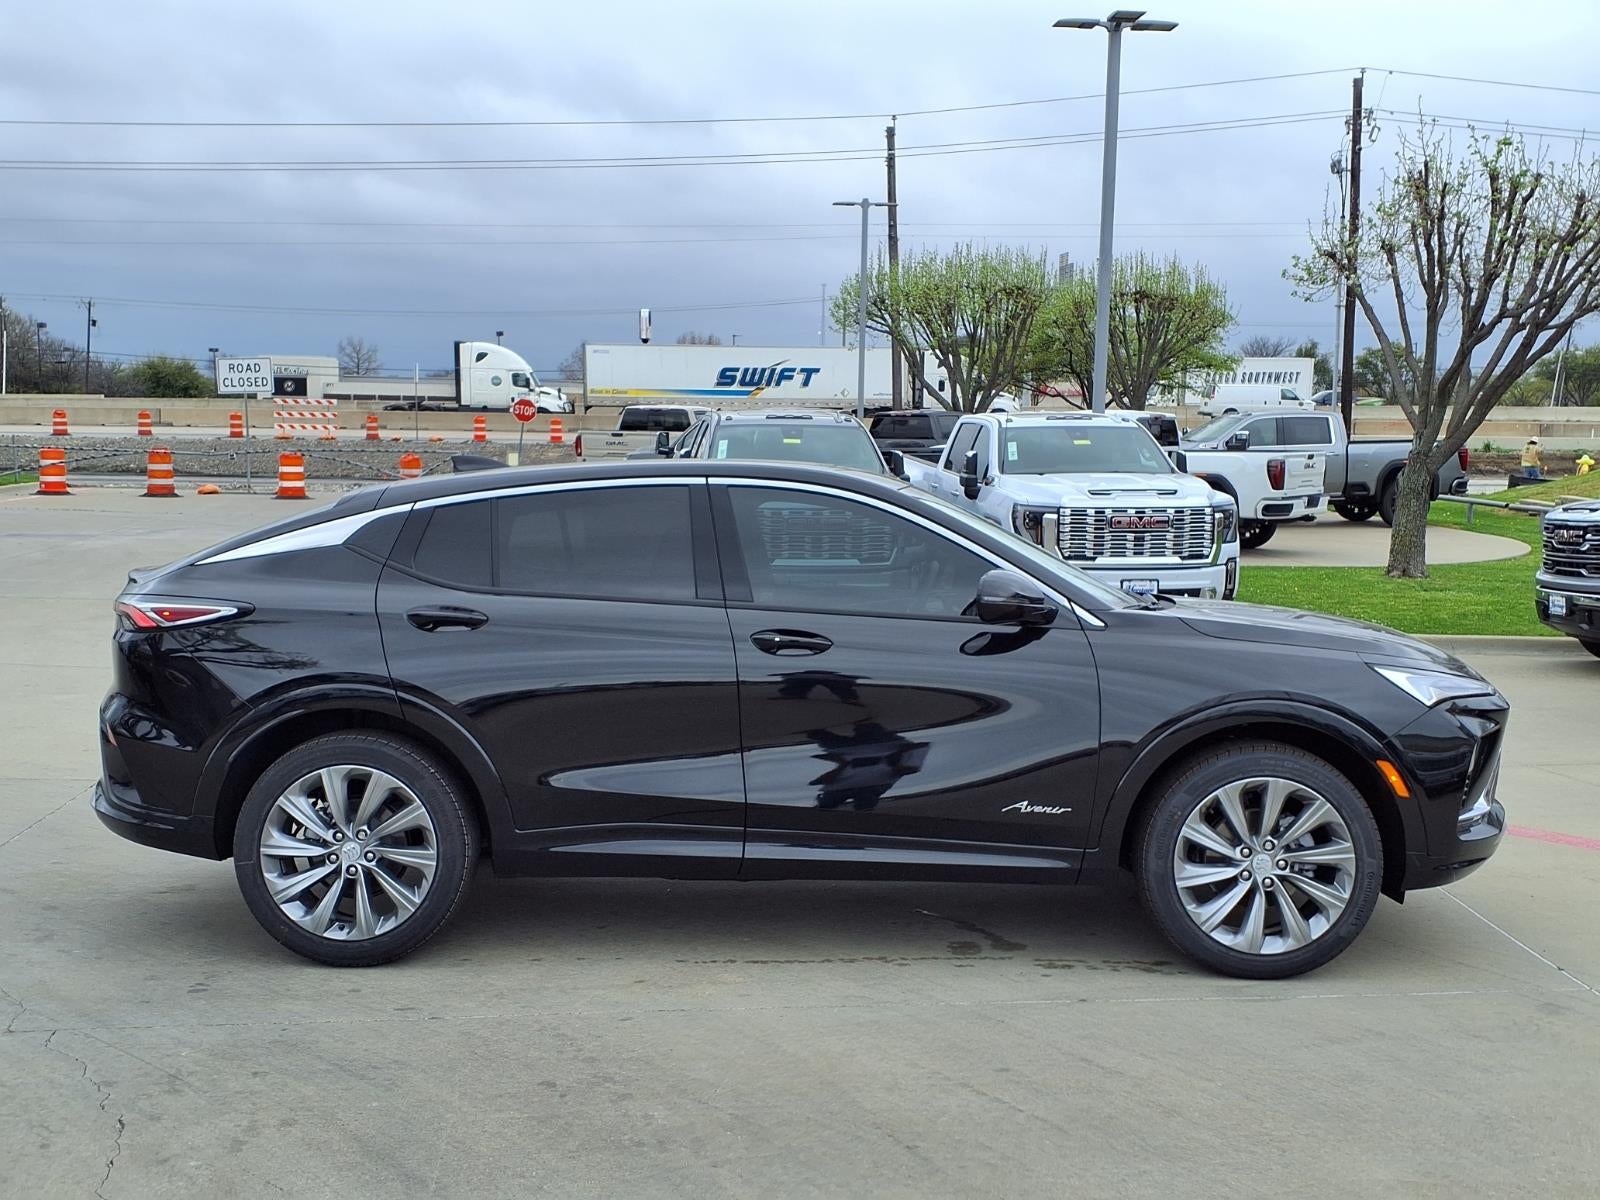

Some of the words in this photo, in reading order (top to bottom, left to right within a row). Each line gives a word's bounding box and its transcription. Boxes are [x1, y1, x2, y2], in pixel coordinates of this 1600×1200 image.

[228, 362, 261, 374] ROAD
[222, 376, 269, 388] CLOSED
[715, 366, 821, 389] SWIFT
[1205, 371, 1238, 384] CARGO
[1240, 371, 1302, 385] SOUTHWEST
[514, 404, 536, 416] STOP
[1111, 515, 1170, 529] GMC
[1553, 529, 1584, 543] GMC
[1001, 800, 1073, 814] Avenir
